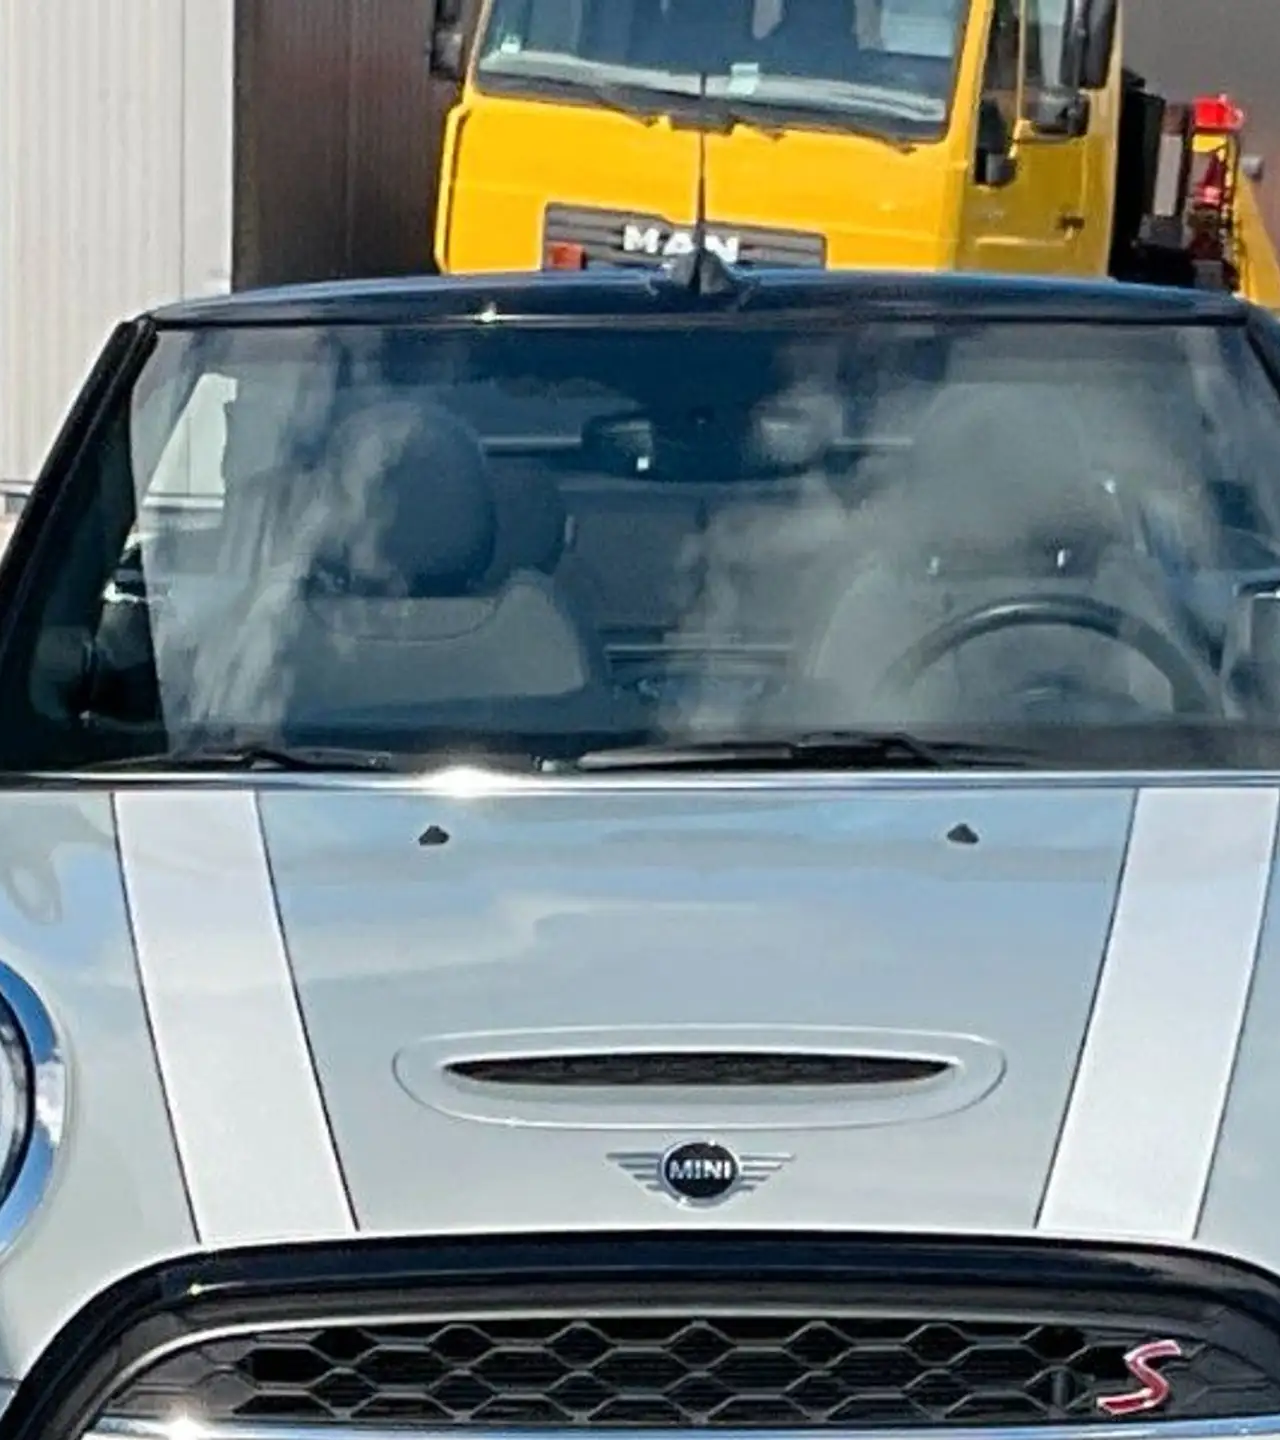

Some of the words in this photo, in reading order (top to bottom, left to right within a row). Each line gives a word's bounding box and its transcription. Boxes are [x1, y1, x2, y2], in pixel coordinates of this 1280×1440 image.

[622, 224, 740, 263] MAN
[670, 1159, 732, 1180] MINI
[1096, 1339, 1182, 1415] S
